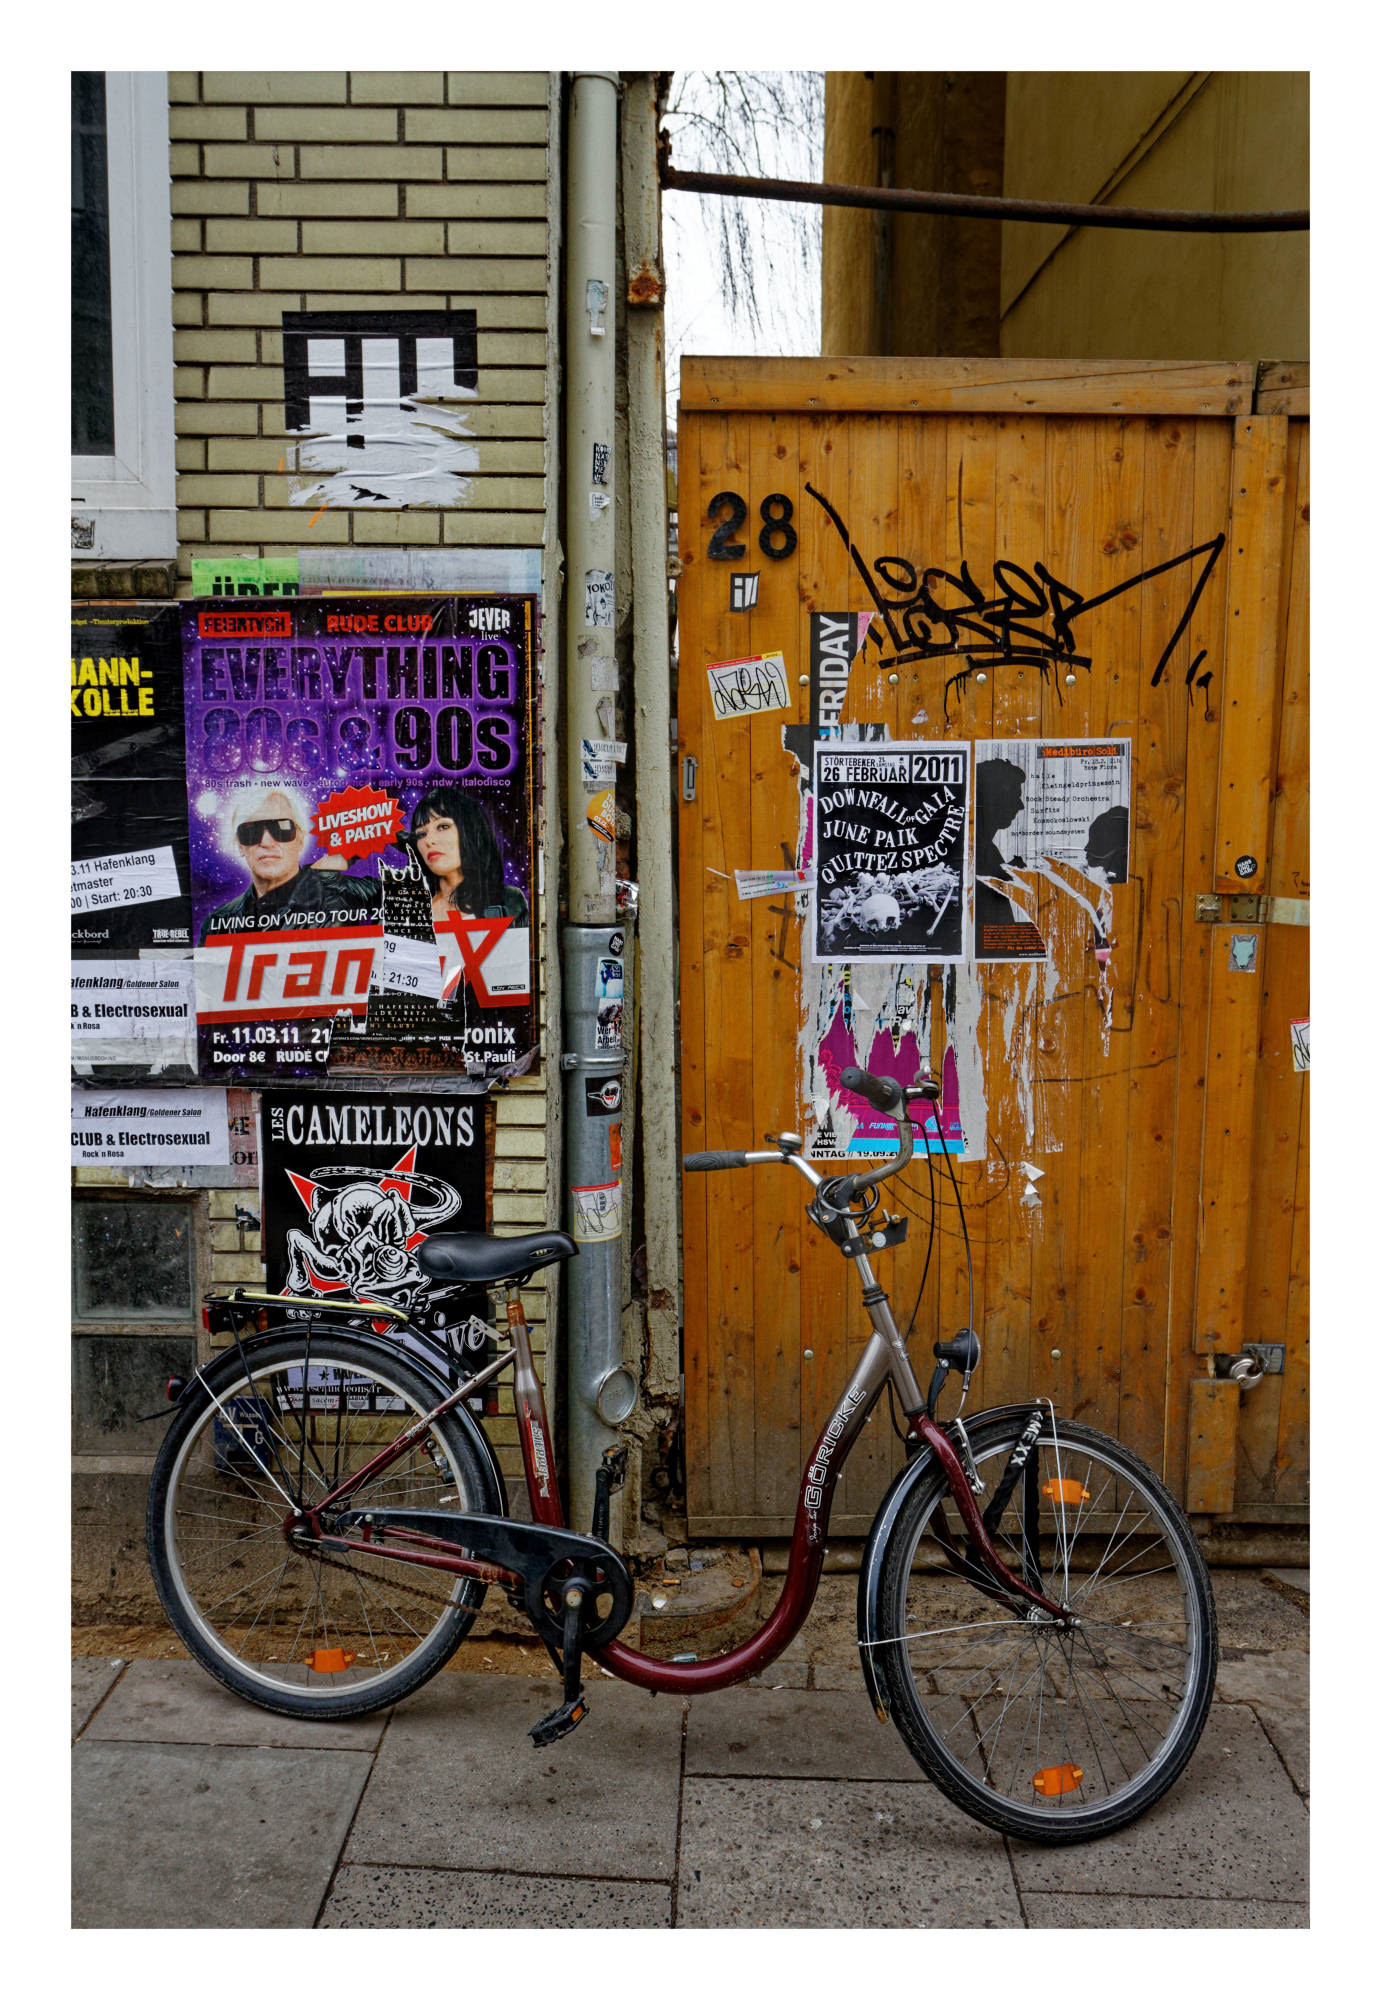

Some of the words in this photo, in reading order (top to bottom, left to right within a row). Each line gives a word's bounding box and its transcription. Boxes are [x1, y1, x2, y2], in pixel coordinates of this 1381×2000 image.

[707, 491, 798, 560] 28
[327, 615, 379, 632] RUDE
[384, 615, 433, 632] CLUB
[469, 607, 511, 631] JEVER
[481, 631, 499, 641] live
[202, 645, 510, 700] EVERYTHING
[819, 614, 849, 727] FRIDAY
[338, 716, 382, 772] &
[394, 706, 512, 772] 90s
[823, 767, 840, 782] 26
[846, 767, 908, 782] FEBRUAR
[913, 757, 960, 782] 2011
[824, 756, 876, 767] STÖRTEBEKER
[205, 779, 222, 788] 80s
[226, 779, 251, 788] trash
[379, 778, 403, 789] early
[406, 778, 424, 788] 90s
[432, 778, 454, 787] ndw
[462, 778, 511, 788] italodisco
[819, 787, 908, 826] DOWNFALL
[914, 785, 956, 825] GAIA
[318, 801, 393, 831] LIVESHOW
[330, 832, 342, 847] &
[345, 821, 393, 844] PARTY
[823, 819, 871, 844] JUNE
[873, 827, 920, 848] PAIK
[821, 851, 899, 884] QUITTEZ
[901, 805, 965, 868] SPECTRE
[94, 853, 156, 872] Hafenklang
[91, 892, 120, 906] Start:
[123, 884, 152, 900] 20:30
[210, 914, 255, 930] LIVING
[257, 913, 280, 928] ON
[284, 911, 326, 925] VIDEO
[330, 909, 367, 923] TOUR
[159, 980, 179, 988] Salon
[389, 971, 419, 988] 21:30
[82, 1005, 92, 1018] &
[94, 1003, 188, 1018] Electrosexual
[83, 1022, 100, 1030] Rosa
[213, 1032, 229, 1044] Fr.
[232, 1027, 299, 1044] 11.03.11
[597, 1025, 611, 1034] Wer
[213, 1051, 246, 1062] Door
[249, 1051, 266, 1063] 8€
[276, 1051, 312, 1063] RUDE
[465, 1050, 516, 1063] St.Pauli
[182, 1108, 202, 1116] Salon
[271, 1107, 285, 1142] LES
[286, 1104, 475, 1147] CAMELEONS
[71, 1132, 103, 1146] CLUB
[106, 1134, 116, 1146] &
[119, 1131, 210, 1146] Electrosexual
[82, 1150, 99, 1158] Rock
[107, 1150, 124, 1158] Rosa
[804, 1383, 867, 1510] GÖRICKE
